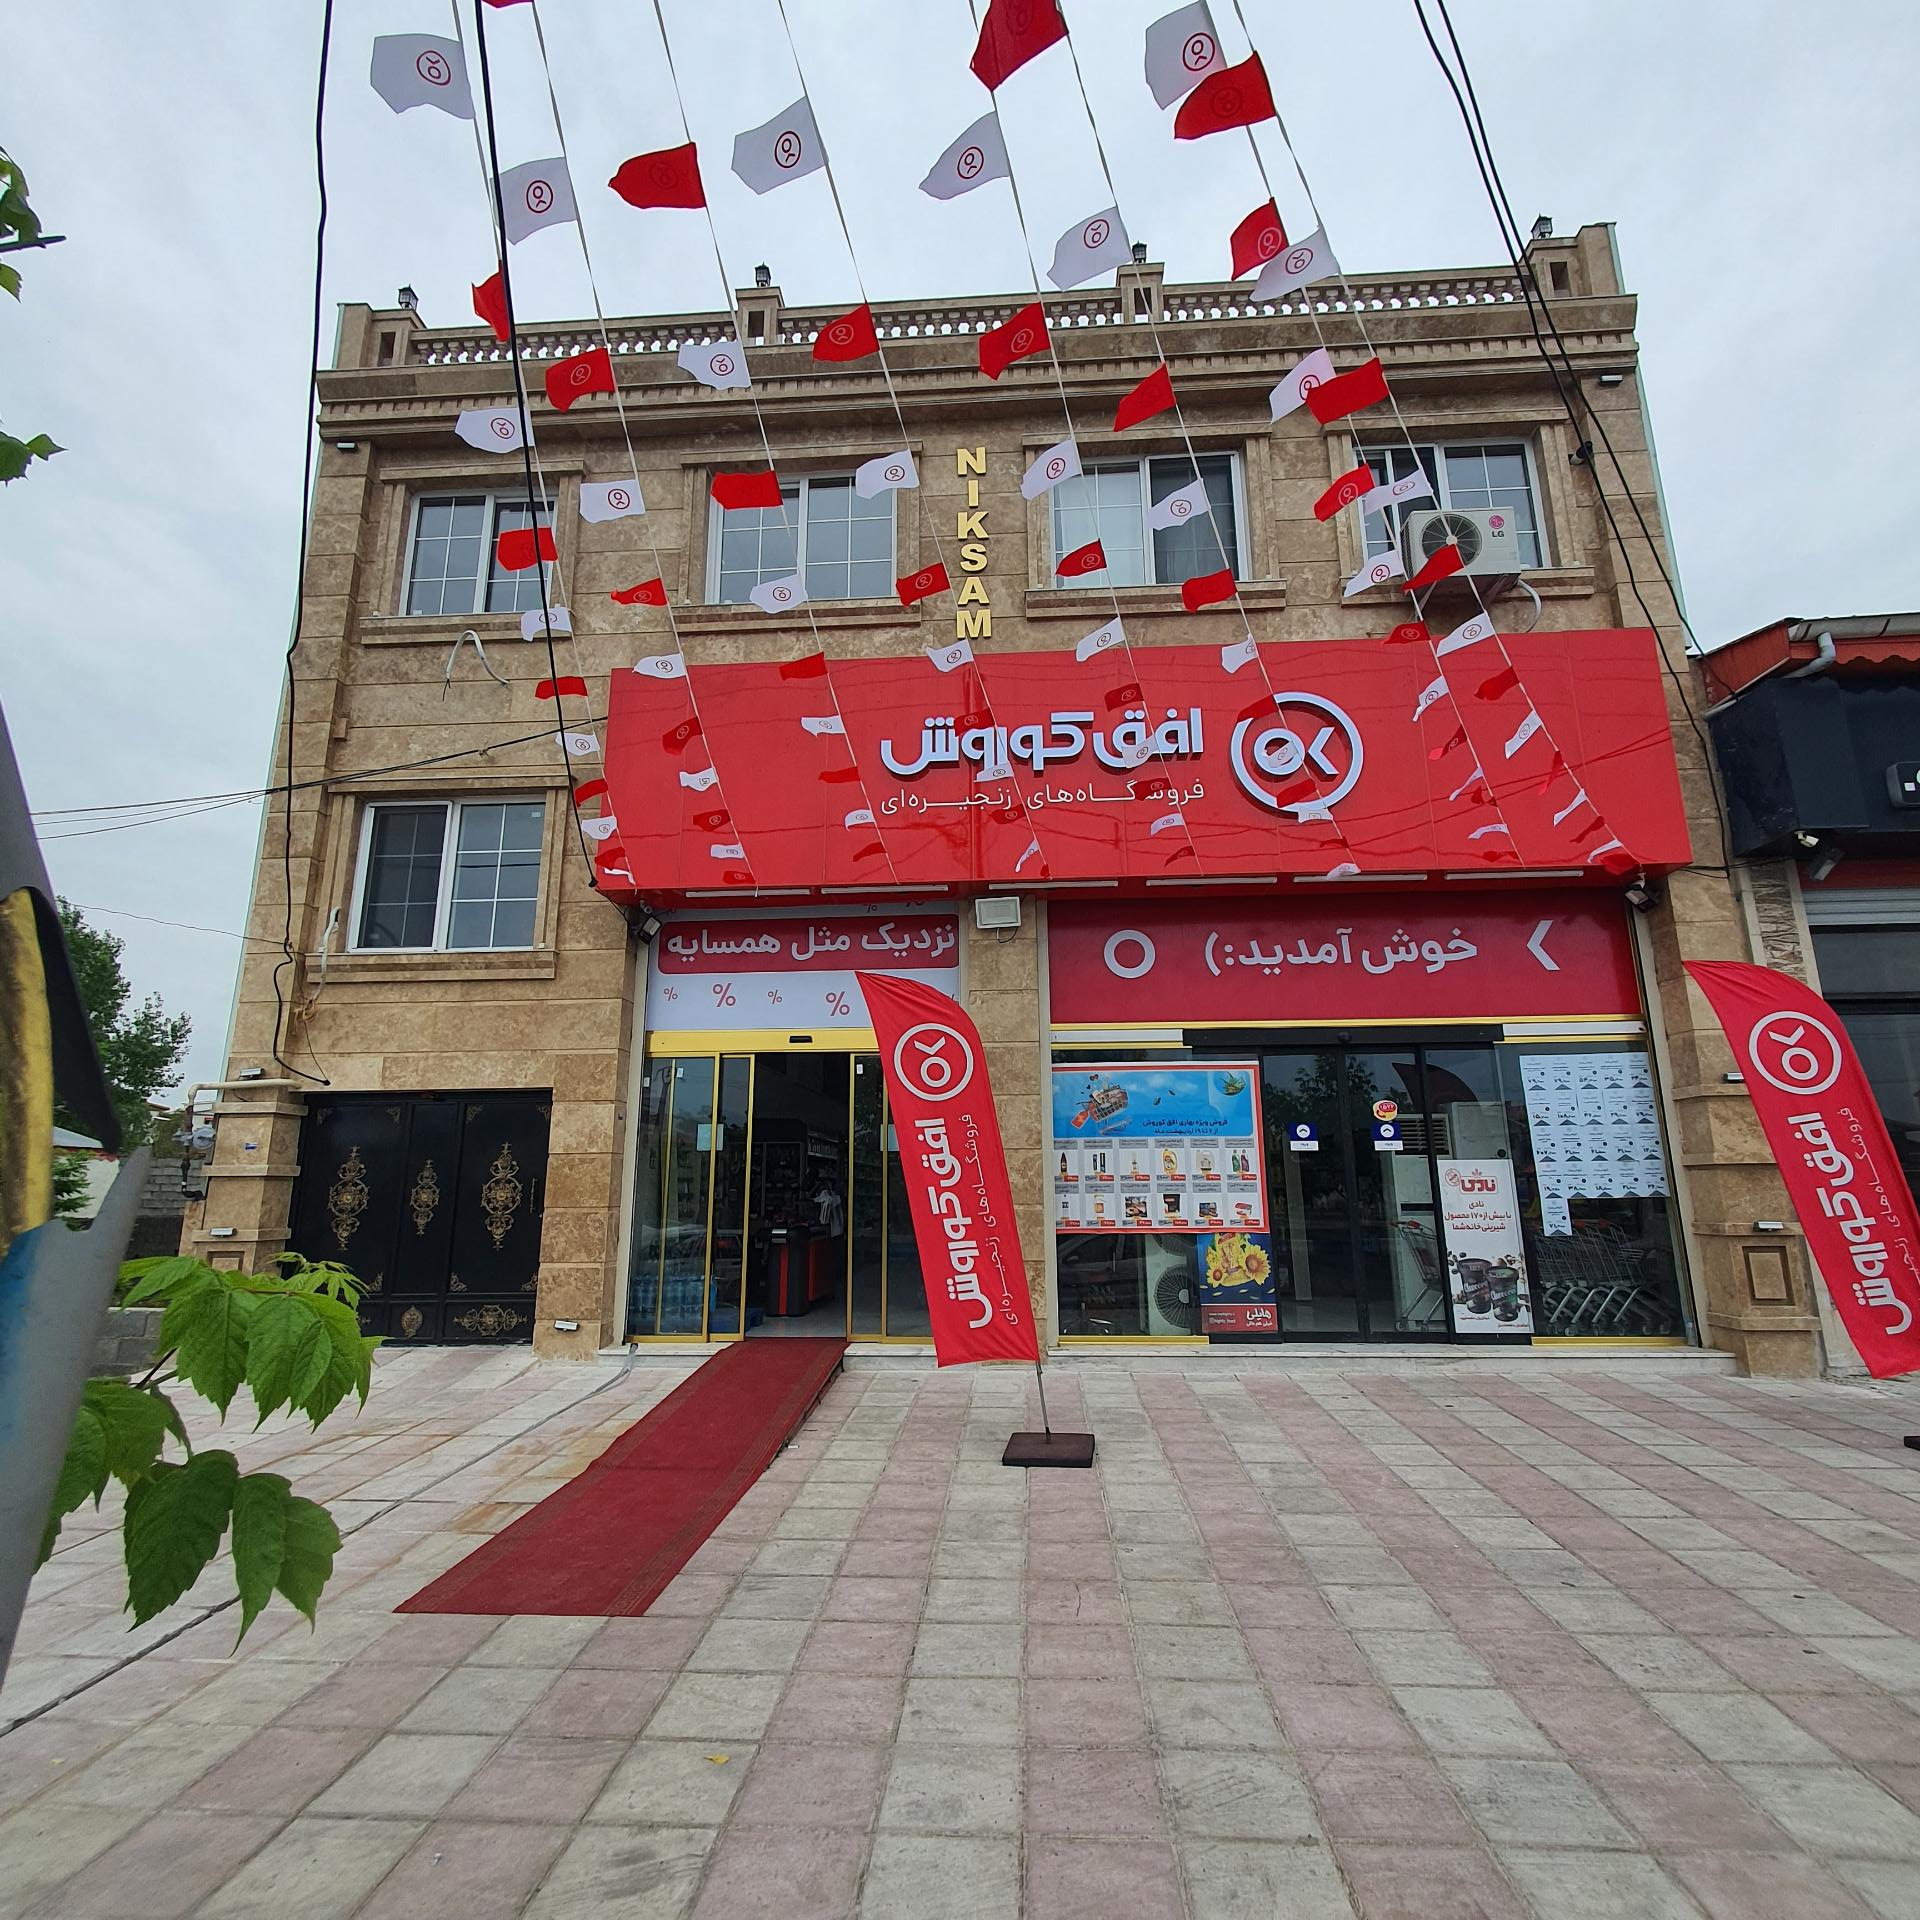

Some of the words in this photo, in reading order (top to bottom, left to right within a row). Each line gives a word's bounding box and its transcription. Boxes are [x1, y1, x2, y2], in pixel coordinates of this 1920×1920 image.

[956, 446, 992, 640] NIKSAM
[1491, 530, 1505, 539] LG
[880, 711, 1095, 775] کوروش
[1092, 707, 1204, 769] افق
[666, 928, 781, 962] همسایه
[790, 925, 851, 961] مثل
[860, 922, 956, 958] نزدیک
[1360, 927, 1478, 975] خوش
[914, 1117, 963, 1188] افق
[1787, 1111, 1855, 1187] افق
[1444, 1211, 1470, 1221] محصول
[1468, 1200, 1485, 1210] نادی
[927, 1186, 994, 1330] کوروش
[1816, 1187, 1913, 1335] کوروش
